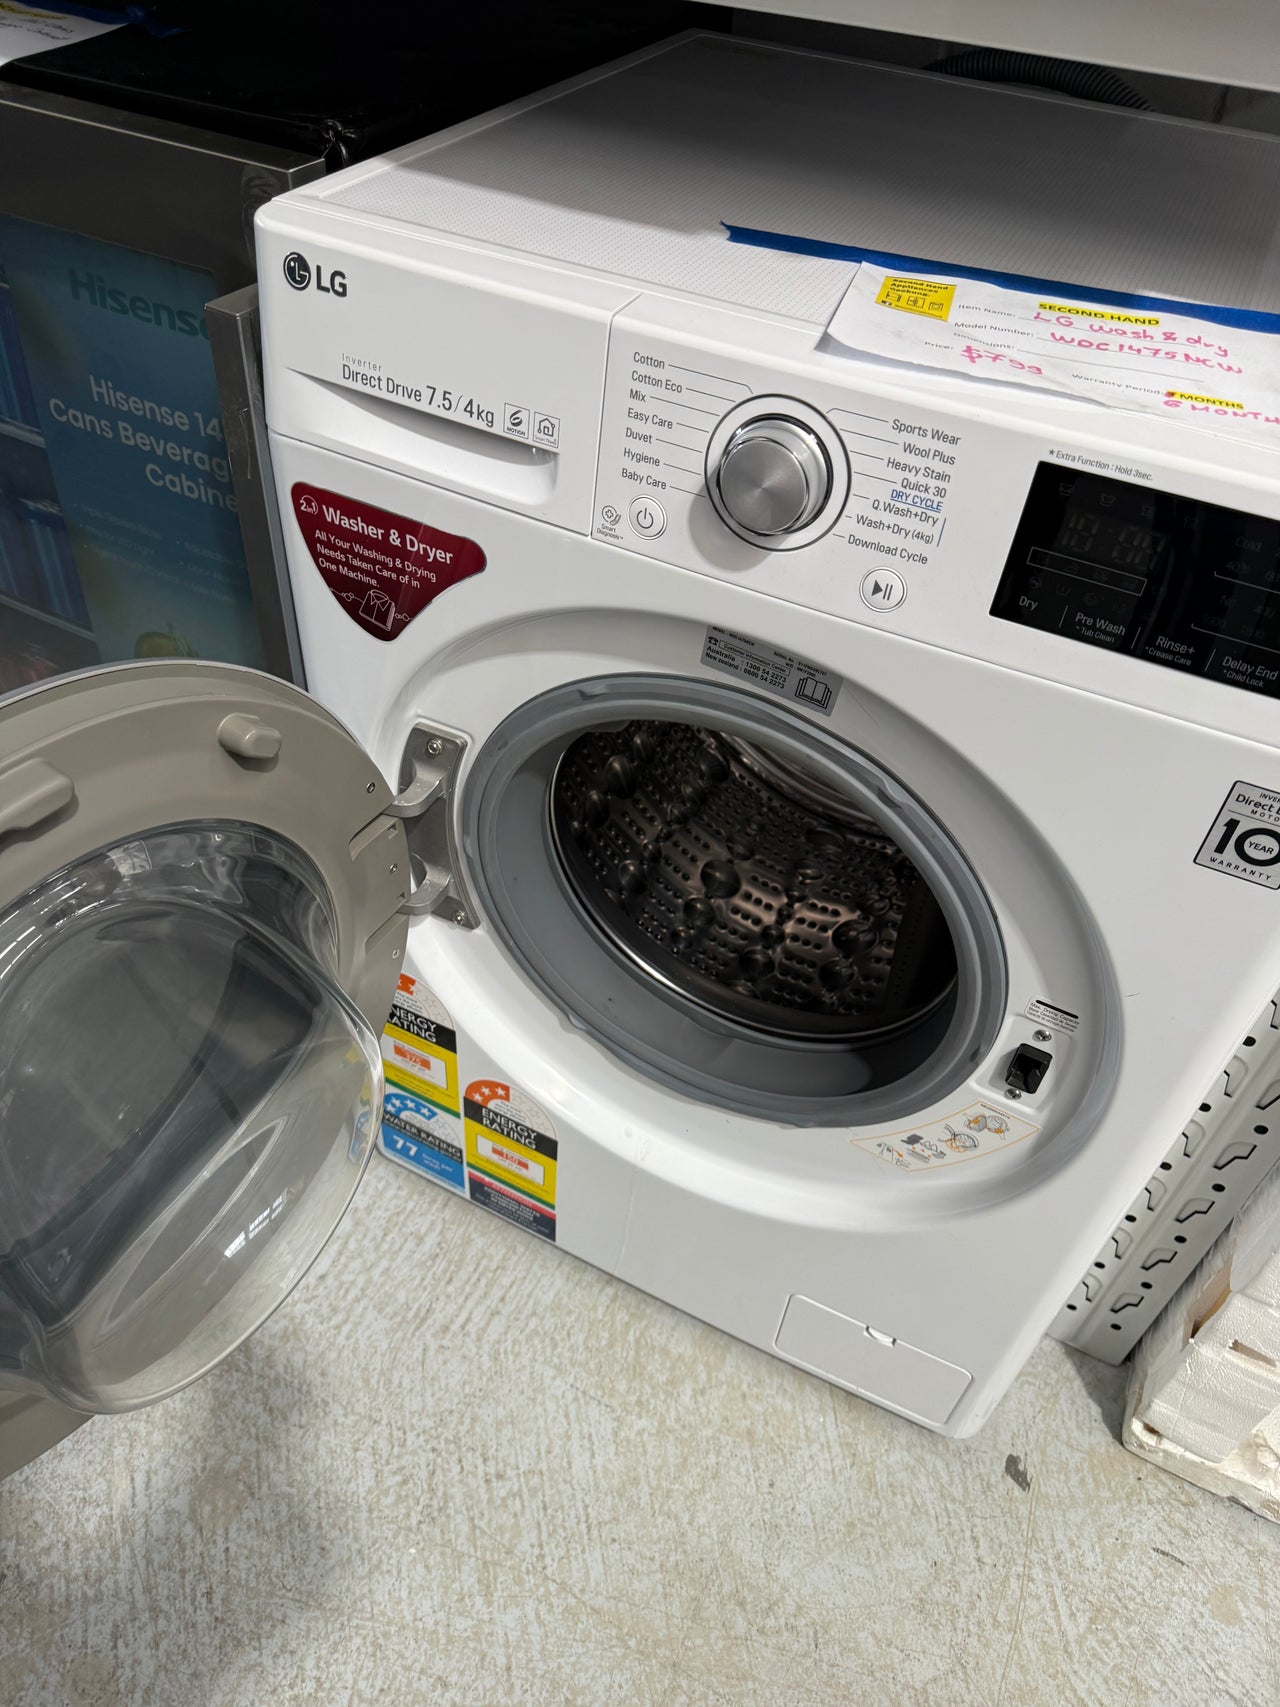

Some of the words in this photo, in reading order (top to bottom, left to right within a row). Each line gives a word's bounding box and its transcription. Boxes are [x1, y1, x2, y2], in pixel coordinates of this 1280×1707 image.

[316, 265, 348, 297] LG
[957, 303, 982, 312] Item
[1039, 303, 1106, 319] SECOND
[1110, 313, 1160, 326] HAND
[954, 321, 987, 331] Model
[1033, 311, 1074, 328] LG
[1162, 331, 1178, 342] &
[1186, 335, 1229, 358] dry
[342, 352, 382, 372] Inverter
[633, 351, 665, 370] Cotton
[342, 363, 382, 391] Direct
[387, 376, 422, 402] Drive
[631, 370, 663, 388] Cotton
[665, 379, 683, 394] Eco
[1071, 372, 1122, 388] Warranty
[89, 375, 190, 431] Hisense
[629, 388, 647, 403] Mix
[1179, 394, 1245, 410] MONTHS
[50, 398, 114, 439] Cans
[627, 407, 650, 424] Easy
[651, 414, 674, 430] Care
[625, 427, 653, 445] Duvet
[891, 418, 928, 439] Sports
[931, 428, 961, 446] Wear
[623, 447, 661, 467] Hygiene
[903, 441, 930, 459] Wool
[932, 450, 956, 466] Plus
[1056, 449, 1076, 463] Extra
[1077, 456, 1110, 472] Function
[1114, 465, 1132, 478] Hold
[1132, 469, 1153, 481] 3sec.
[621, 467, 645, 484] Baby
[646, 476, 667, 490] Care
[886, 457, 921, 478] Heavy
[922, 466, 951, 483] Stain
[901, 478, 930, 495] Quick
[934, 486, 947, 499] 30
[890, 489, 910, 504] DRY
[912, 493, 943, 512] CYCLE
[322, 504, 385, 541] Washer
[389, 531, 402, 547] &
[406, 534, 453, 565] Dryer
[856, 513, 911, 539] Wash+Dry
[911, 529, 934, 545] (4kg)
[315, 529, 328, 541] All
[329, 533, 351, 549] Your
[352, 542, 393, 567] Washing
[395, 557, 402, 568] &
[405, 561, 437, 583] Drying
[847, 534, 897, 557] Download
[899, 548, 928, 565] Cycle
[316, 543, 346, 562] Needs
[346, 554, 374, 572] Taken
[375, 565, 397, 580] Care
[399, 573, 410, 585] of
[411, 577, 421, 589] in
[318, 558, 338, 572] One
[339, 564, 380, 588] Machine.
[1018, 595, 1038, 610] Dry
[1075, 612, 1094, 628] Pre
[1096, 618, 1126, 636] Wash
[1081, 627, 1093, 637] Tub
[1094, 631, 1115, 644] Clean
[705, 652, 717, 661] New
[707, 646, 736, 662] Australia
[1148, 646, 1174, 661] Crease
[1175, 653, 1192, 666] Care
[1156, 635, 1196, 655] Rinse+
[1222, 656, 1254, 675] Delay
[1257, 664, 1278, 681] End
[1226, 669, 1246, 683] Child
[1247, 676, 1264, 688] Lock
[1235, 793, 1275, 813] Direct
[1213, 817, 1280, 867] 10
[1247, 841, 1274, 855] YEAR
[1210, 856, 1272, 881] WARRANTY
[388, 1016, 437, 1043] ATING
[383, 1112, 420, 1136] WATER
[420, 1129, 460, 1157] RATING
[482, 1107, 537, 1140] ENERGY
[483, 1117, 536, 1150] RATING
[392, 1134, 418, 1157] 77
